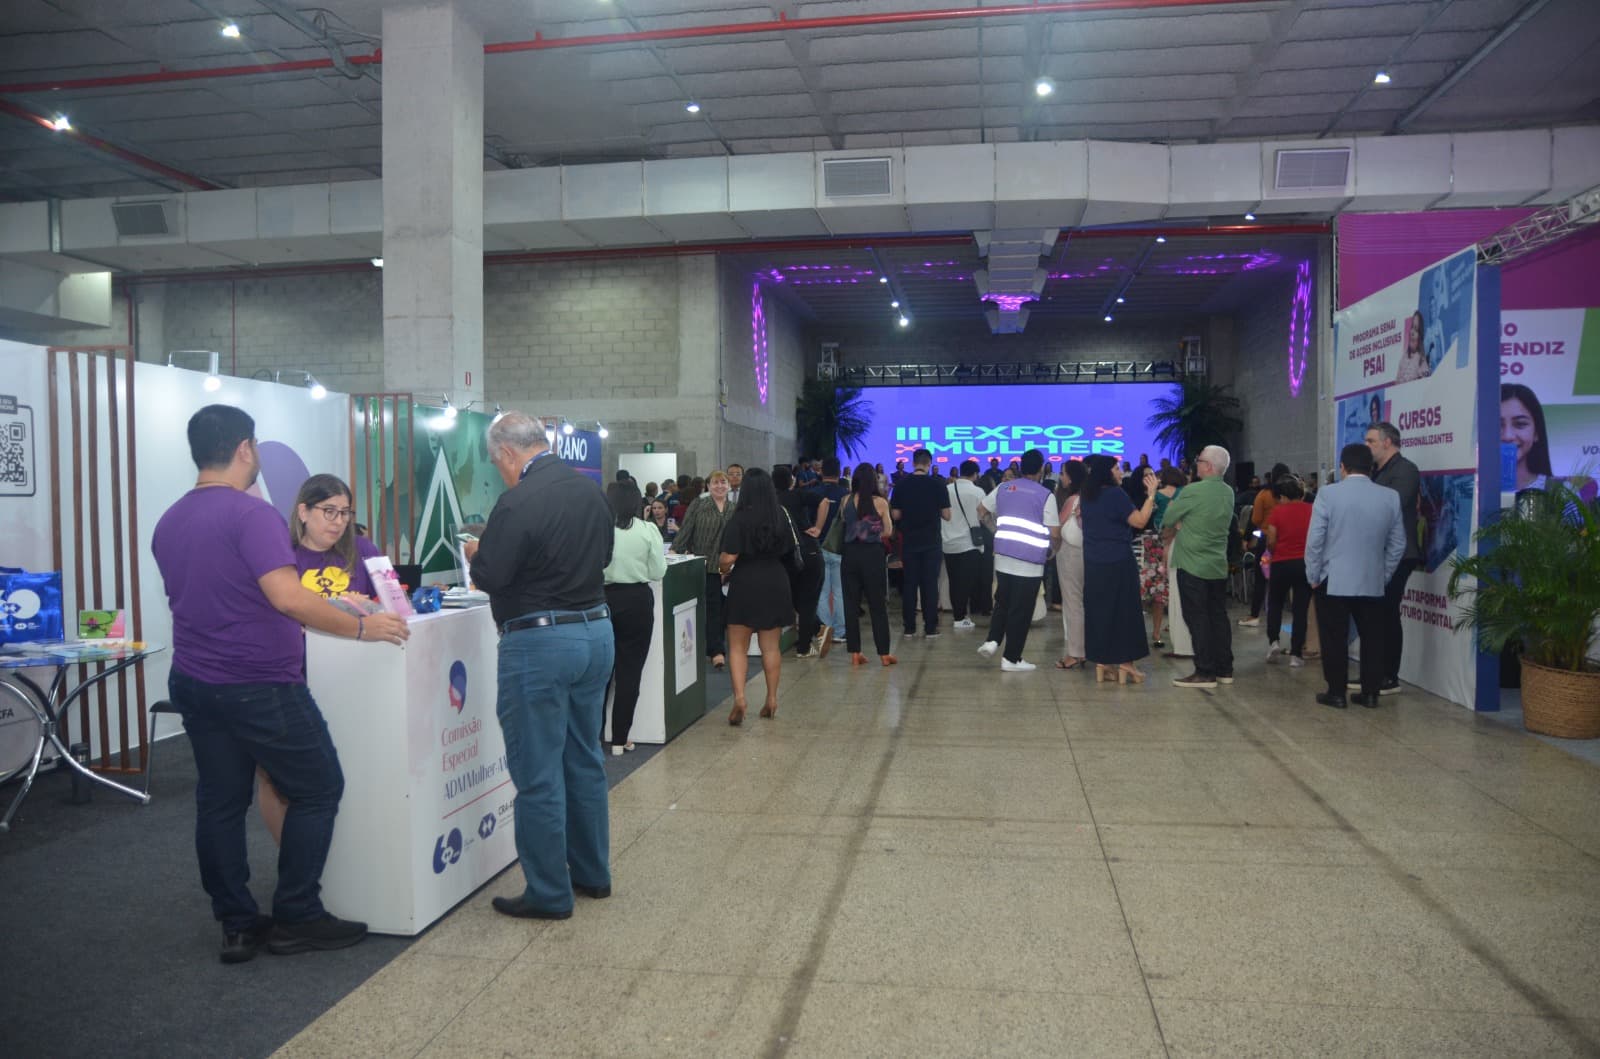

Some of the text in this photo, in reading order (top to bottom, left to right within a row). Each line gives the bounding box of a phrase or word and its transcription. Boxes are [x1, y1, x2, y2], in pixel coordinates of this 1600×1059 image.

[1363, 353, 1385, 378] PSAI
[1398, 405, 1442, 431] CURSOS
[896, 425, 1084, 440] III EXPO
[925, 440, 1125, 455] MULHER
[1423, 610, 1454, 630] DIGITAL
[441, 716, 482, 747] Comissão
[442, 737, 479, 773] Especial
